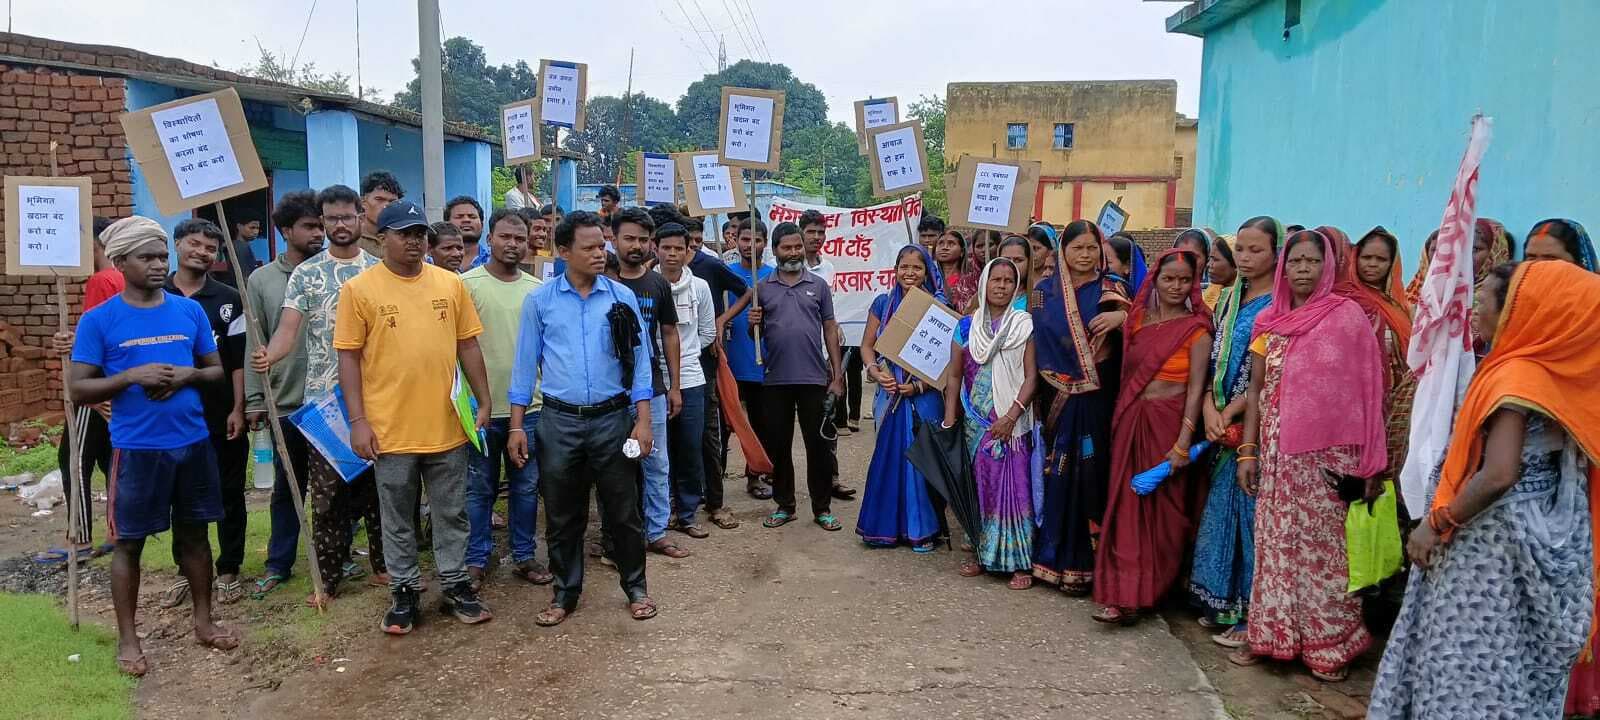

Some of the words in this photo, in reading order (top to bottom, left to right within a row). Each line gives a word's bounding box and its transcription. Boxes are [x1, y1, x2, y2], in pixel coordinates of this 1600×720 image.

[882, 138, 904, 148] आवाज
[176, 148, 194, 158] करना
[26, 196, 55, 206] भूमिगत
[28, 226, 41, 235] करो
[28, 242, 42, 250] करो
[928, 316, 952, 334] आवाज
[919, 329, 928, 338] दो
[929, 336, 942, 348] हम
[912, 344, 924, 354] एक
